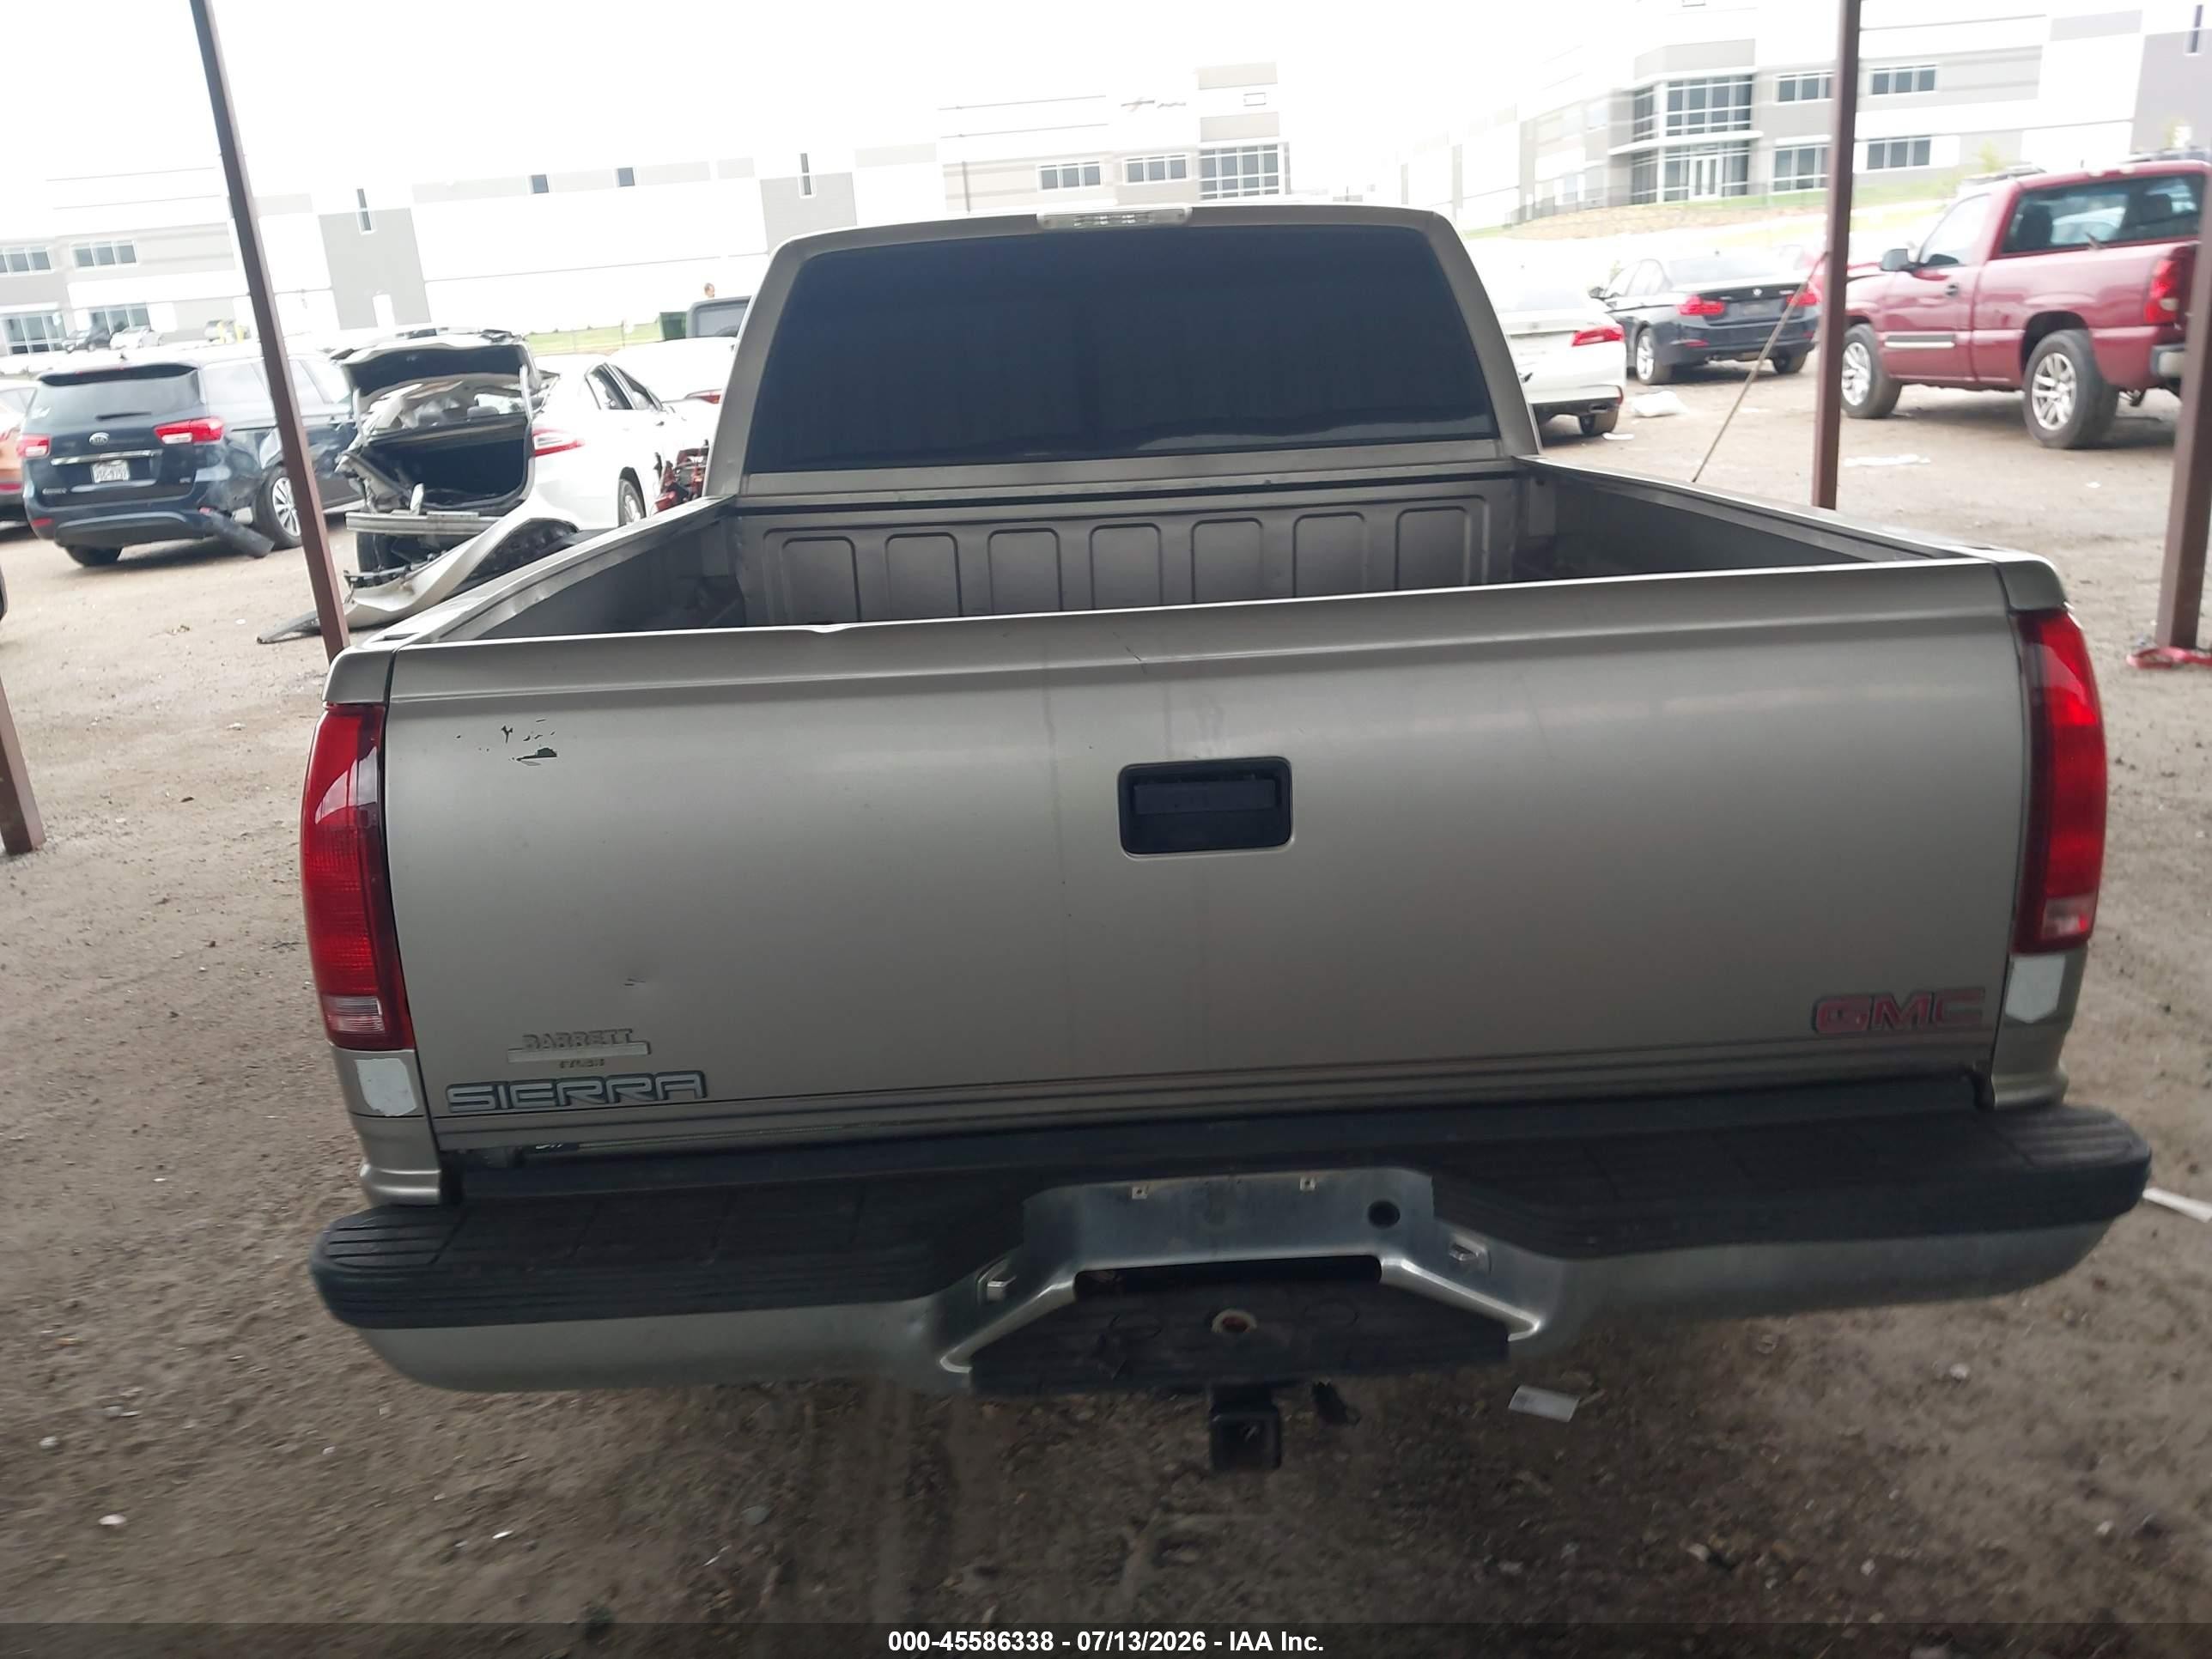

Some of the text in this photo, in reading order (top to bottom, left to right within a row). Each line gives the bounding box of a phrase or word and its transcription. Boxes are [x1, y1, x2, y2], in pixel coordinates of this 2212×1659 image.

[1811, 987, 1985, 1035] GMC
[522, 1027, 634, 1050] BARRETT
[446, 1070, 706, 1114] SIERRA
